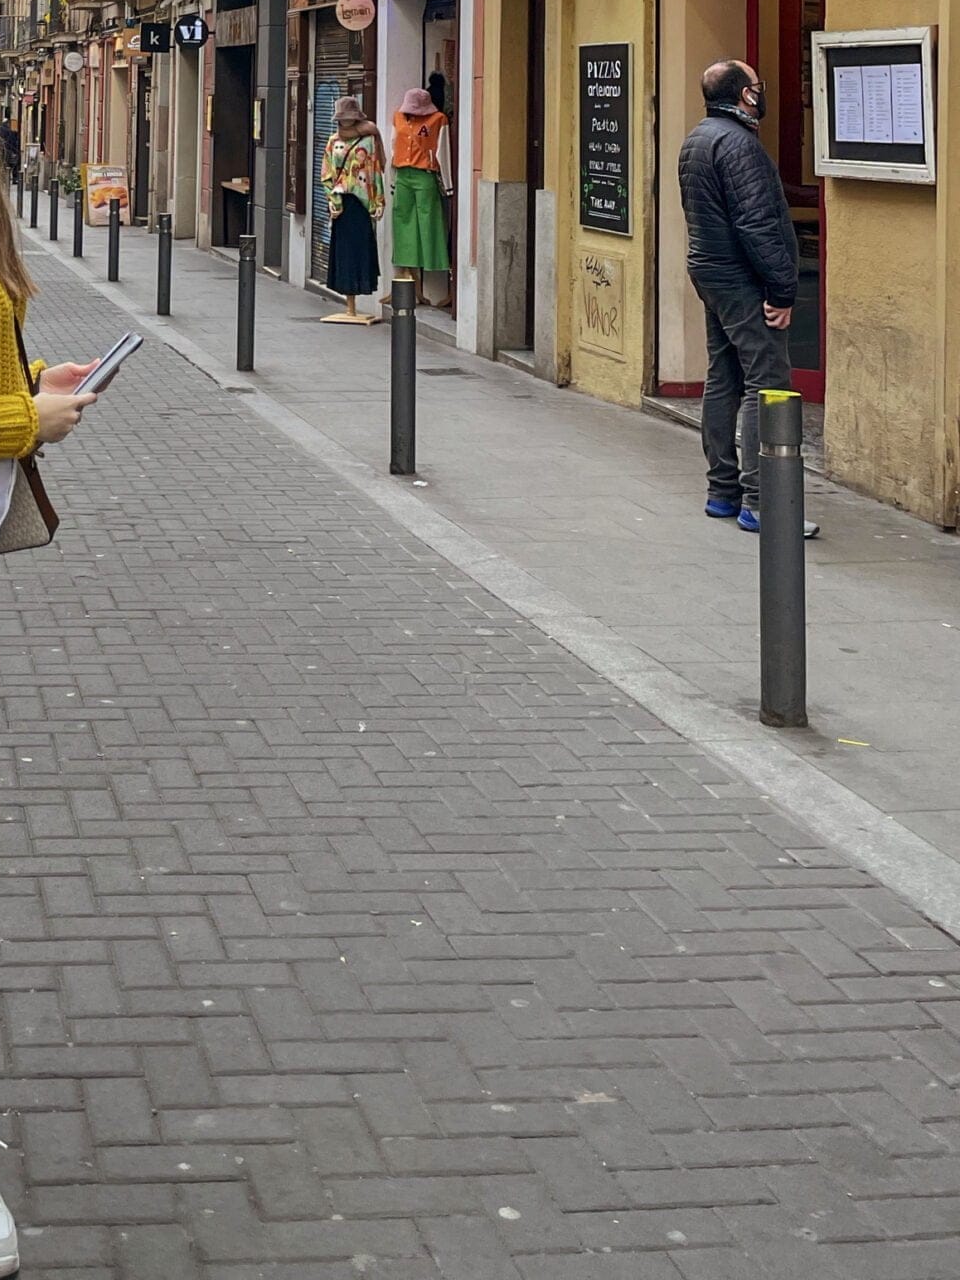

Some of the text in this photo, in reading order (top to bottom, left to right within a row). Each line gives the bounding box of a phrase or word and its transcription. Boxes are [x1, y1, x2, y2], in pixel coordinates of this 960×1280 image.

[179, 20, 203, 40] vi
[587, 60, 621, 79] PIZZAS
[417, 124, 429, 137] A
